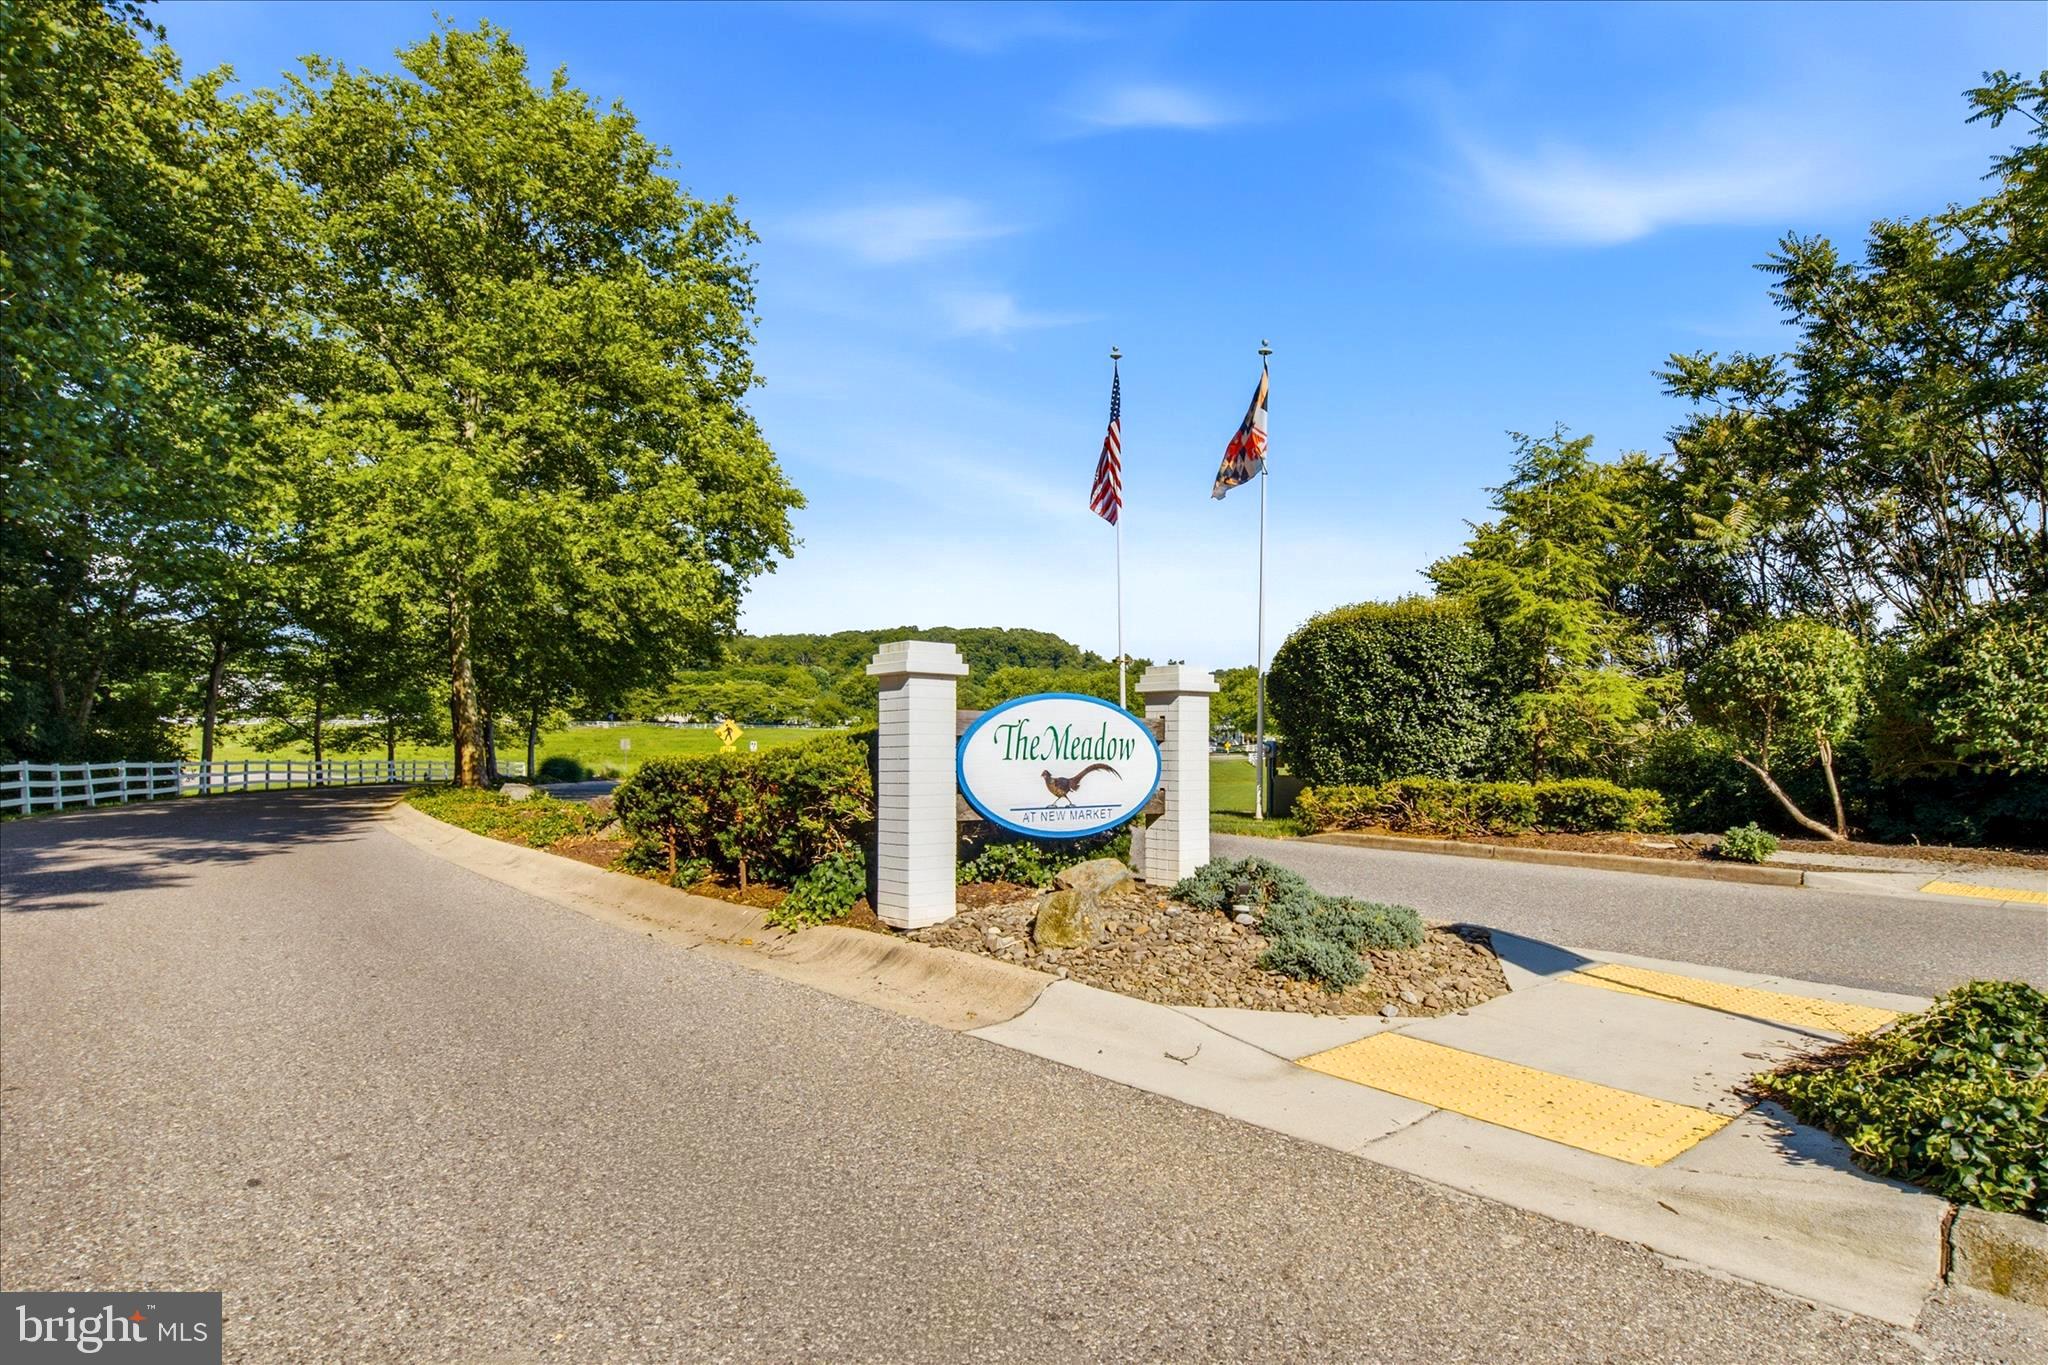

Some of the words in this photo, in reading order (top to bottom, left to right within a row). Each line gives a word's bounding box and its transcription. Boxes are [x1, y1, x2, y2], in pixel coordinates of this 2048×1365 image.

[994, 718, 1040, 761] The
[1040, 721, 1135, 761] Meadow
[1022, 811, 1036, 823] AT
[1040, 810, 1066, 822] NEW
[1069, 808, 1113, 821] MARKET
